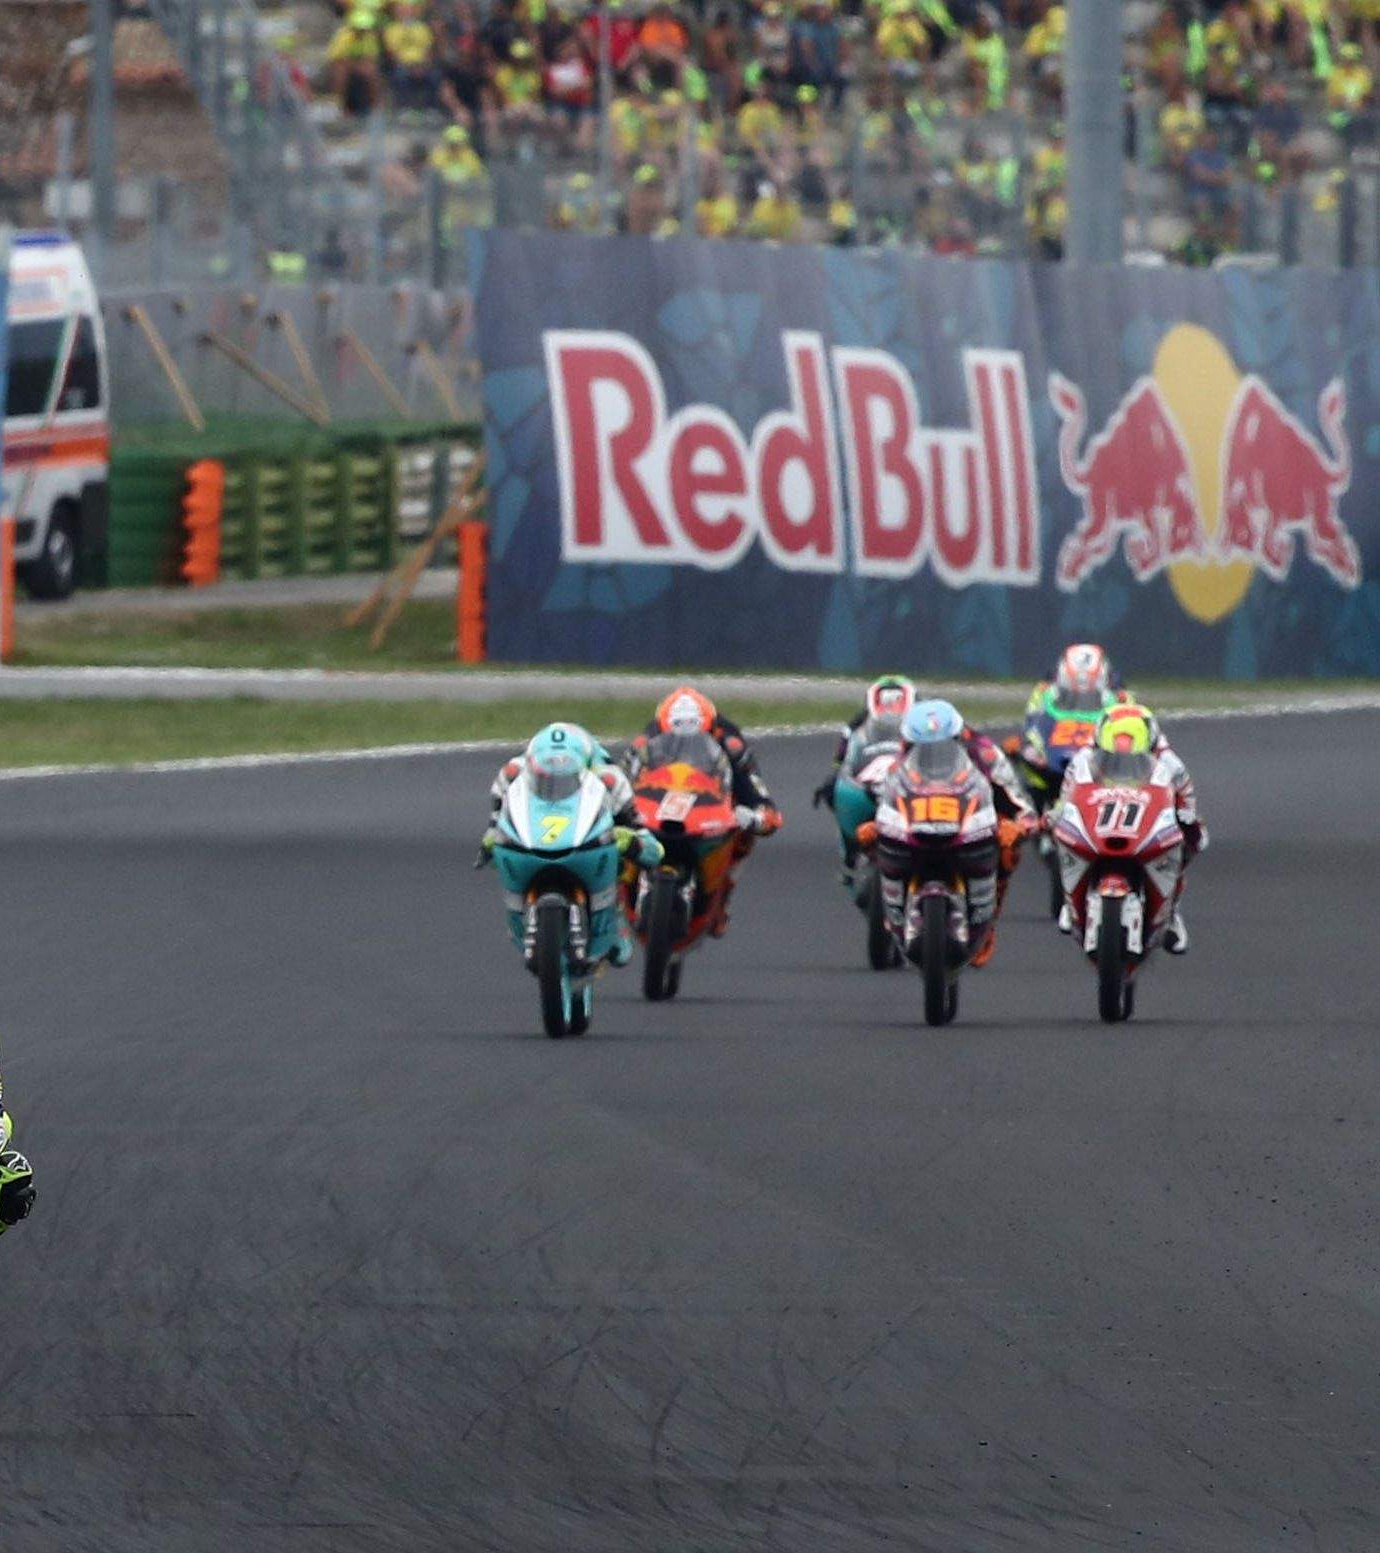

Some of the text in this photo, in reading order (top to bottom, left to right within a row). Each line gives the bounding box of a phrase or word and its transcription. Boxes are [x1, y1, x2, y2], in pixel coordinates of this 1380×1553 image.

[543, 330, 1041, 588] Red Bull
[911, 796, 960, 822] 16
[1097, 801, 1143, 830] 11
[540, 815, 571, 845] 7
